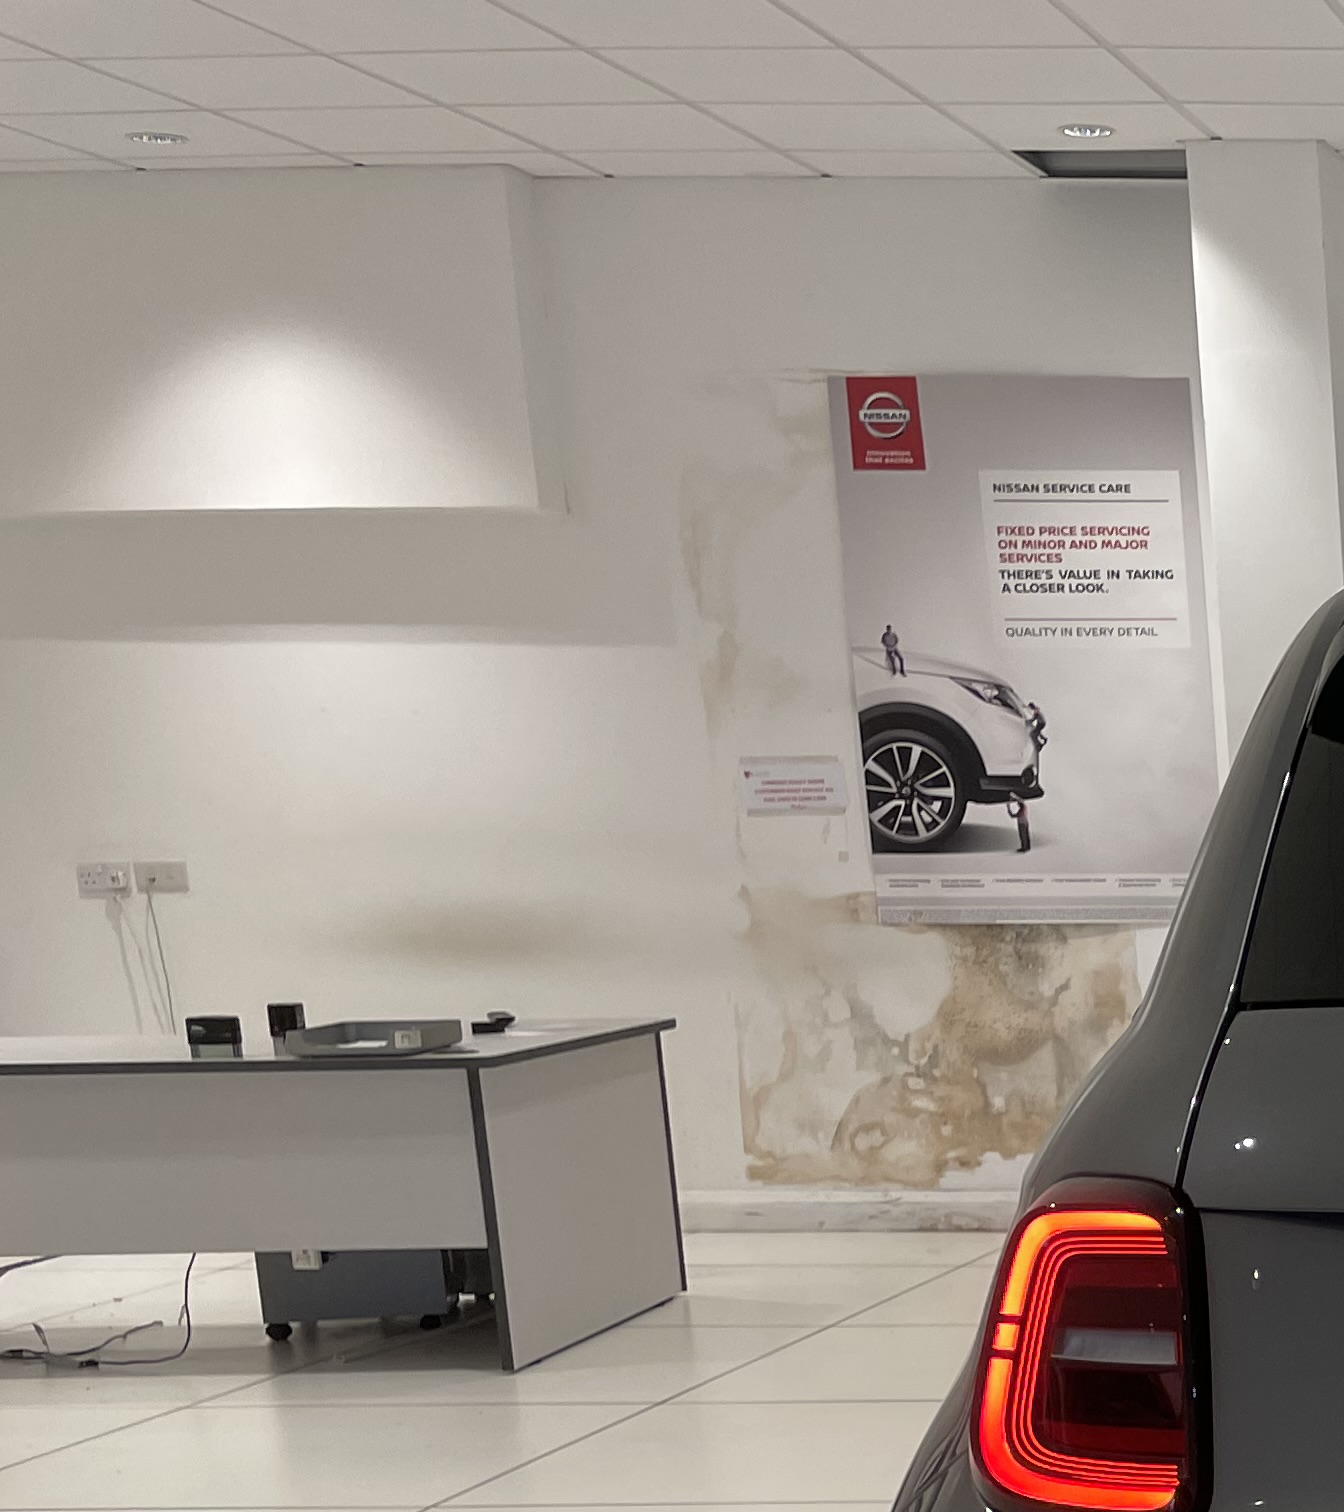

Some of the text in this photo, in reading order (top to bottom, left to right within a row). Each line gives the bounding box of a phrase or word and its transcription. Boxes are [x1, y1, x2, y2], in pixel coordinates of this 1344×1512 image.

[863, 412, 908, 420] NISSAN
[993, 483, 1131, 493] NISSAN SERVICE CARE
[996, 526, 1150, 536] FIXED PRICE SERVICING
[997, 539, 1148, 550] ON MINOR AND MAJOR
[999, 553, 1062, 563] SERVICES
[999, 569, 1174, 580] THERE'S VALUE IN TAKING
[1001, 583, 1109, 593] A CLOSER LOOK.
[1005, 627, 1158, 637] QUALITY IN EVERY DETAIL
